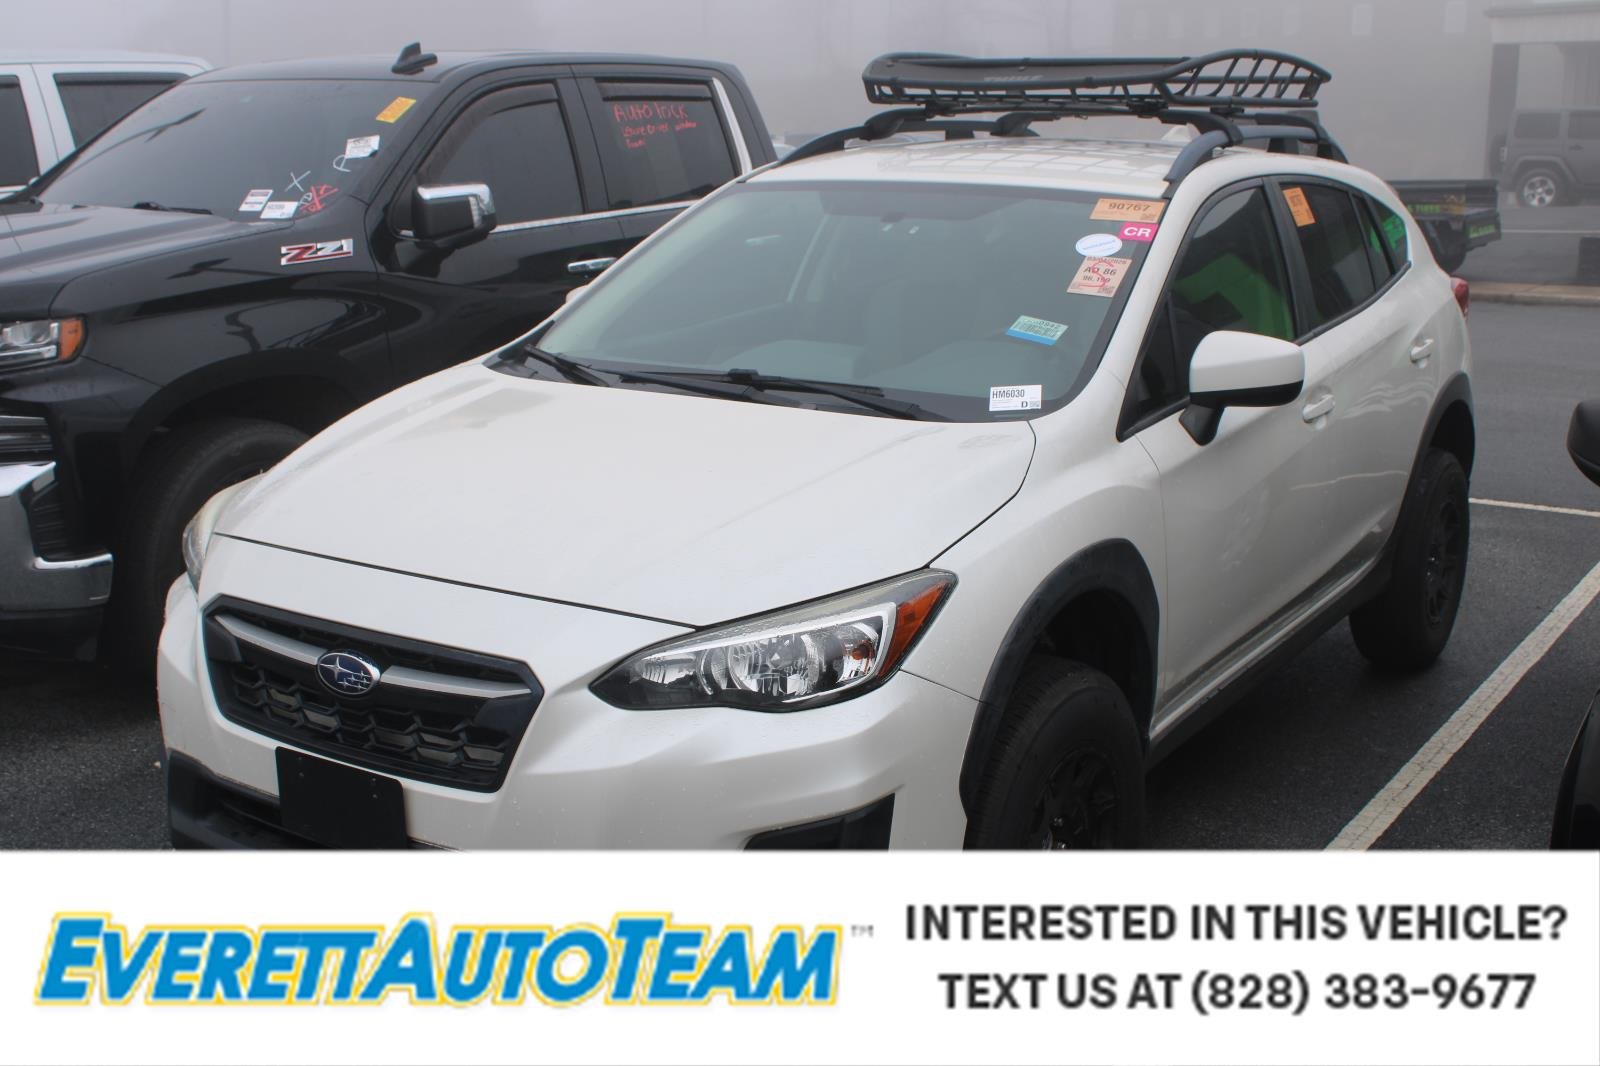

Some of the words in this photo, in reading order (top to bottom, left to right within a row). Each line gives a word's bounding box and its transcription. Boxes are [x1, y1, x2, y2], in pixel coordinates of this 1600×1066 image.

[1107, 202, 1151, 212] 90767
[1123, 226, 1152, 238] CR
[280, 238, 354, 266] Z71
[992, 388, 1025, 400] HM6030
[1021, 400, 1028, 409] D
